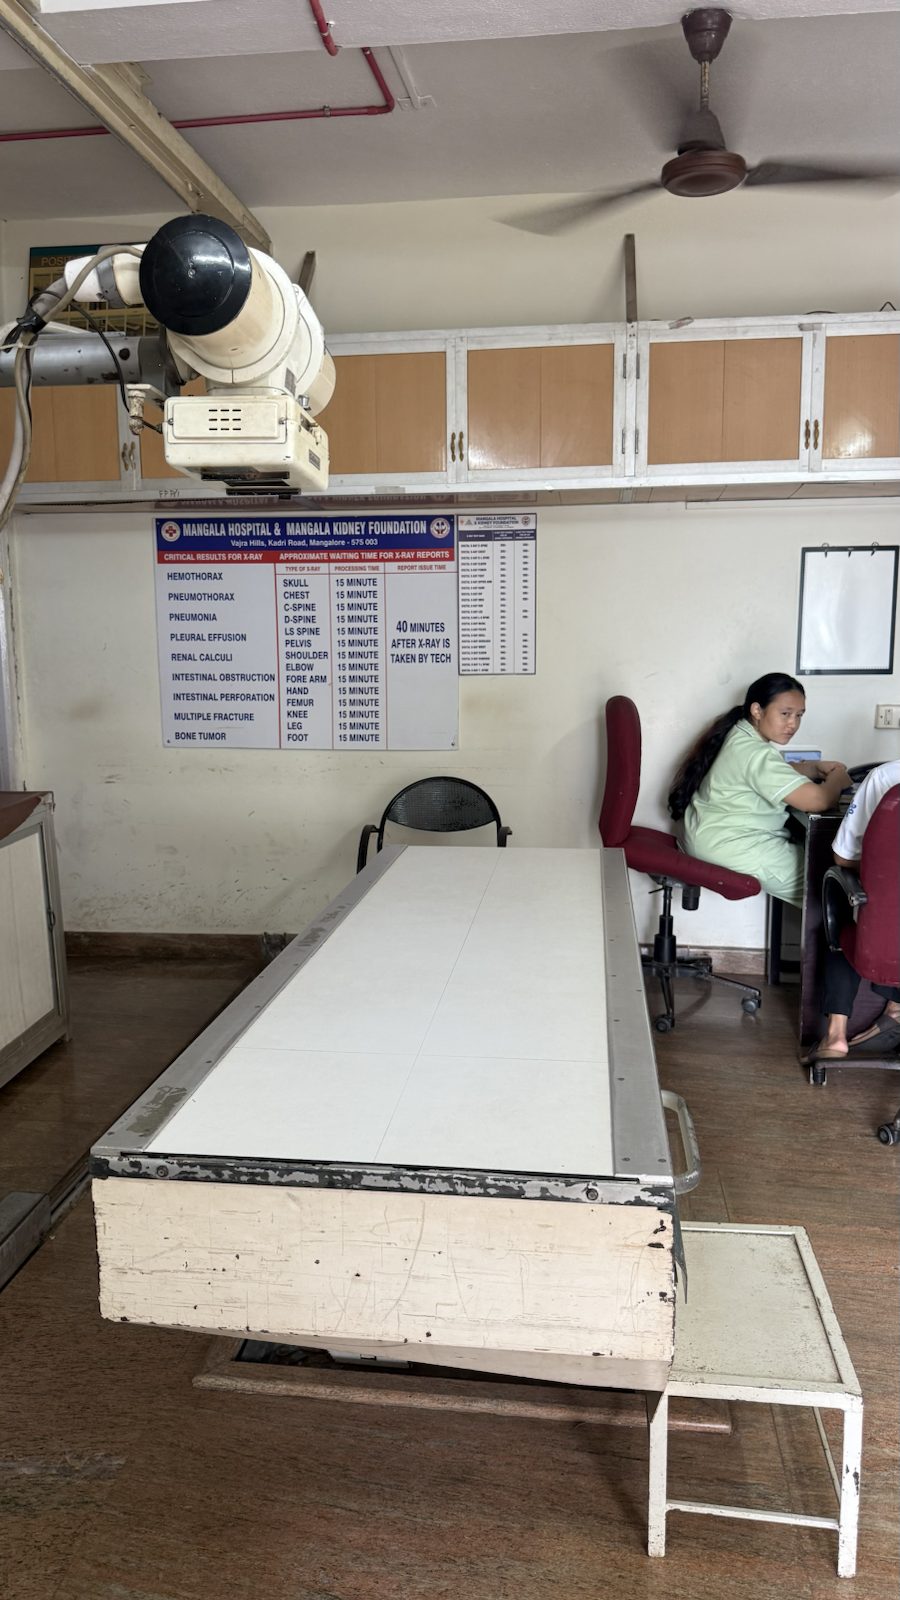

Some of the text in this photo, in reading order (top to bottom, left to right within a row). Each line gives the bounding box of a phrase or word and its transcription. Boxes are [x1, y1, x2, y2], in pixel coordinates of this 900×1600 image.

[183, 520, 426, 537] MANGALA HOSPITAL & MANGALA KIDNEY FOUNDATION
[231, 540, 248, 548] Vajra
[250, 539, 266, 548] Hills,
[288, 539, 307, 547] Road,
[310, 539, 345, 547] Mangalore
[379, 551, 393, 559] FOR
[417, 551, 449, 559] REPORTS
[167, 572, 223, 581] HEMOTHORAX
[168, 593, 234, 601] PNEUMOTHORAX
[336, 603, 377, 611] 15 MINUTE
[169, 613, 217, 621] PNEUMONIA
[396, 621, 445, 632] 40 MINUTES
[170, 633, 246, 642] PLEURAL EFFUSION
[391, 639, 450, 648] AFTER X-RAY IS
[390, 654, 417, 663] TAKEN
[419, 654, 428, 663] BY
[430, 654, 451, 663] TECH
[220, 674, 275, 682] OBSTRUCTION
[173, 693, 275, 702] INTESTINAL PERFORATION
